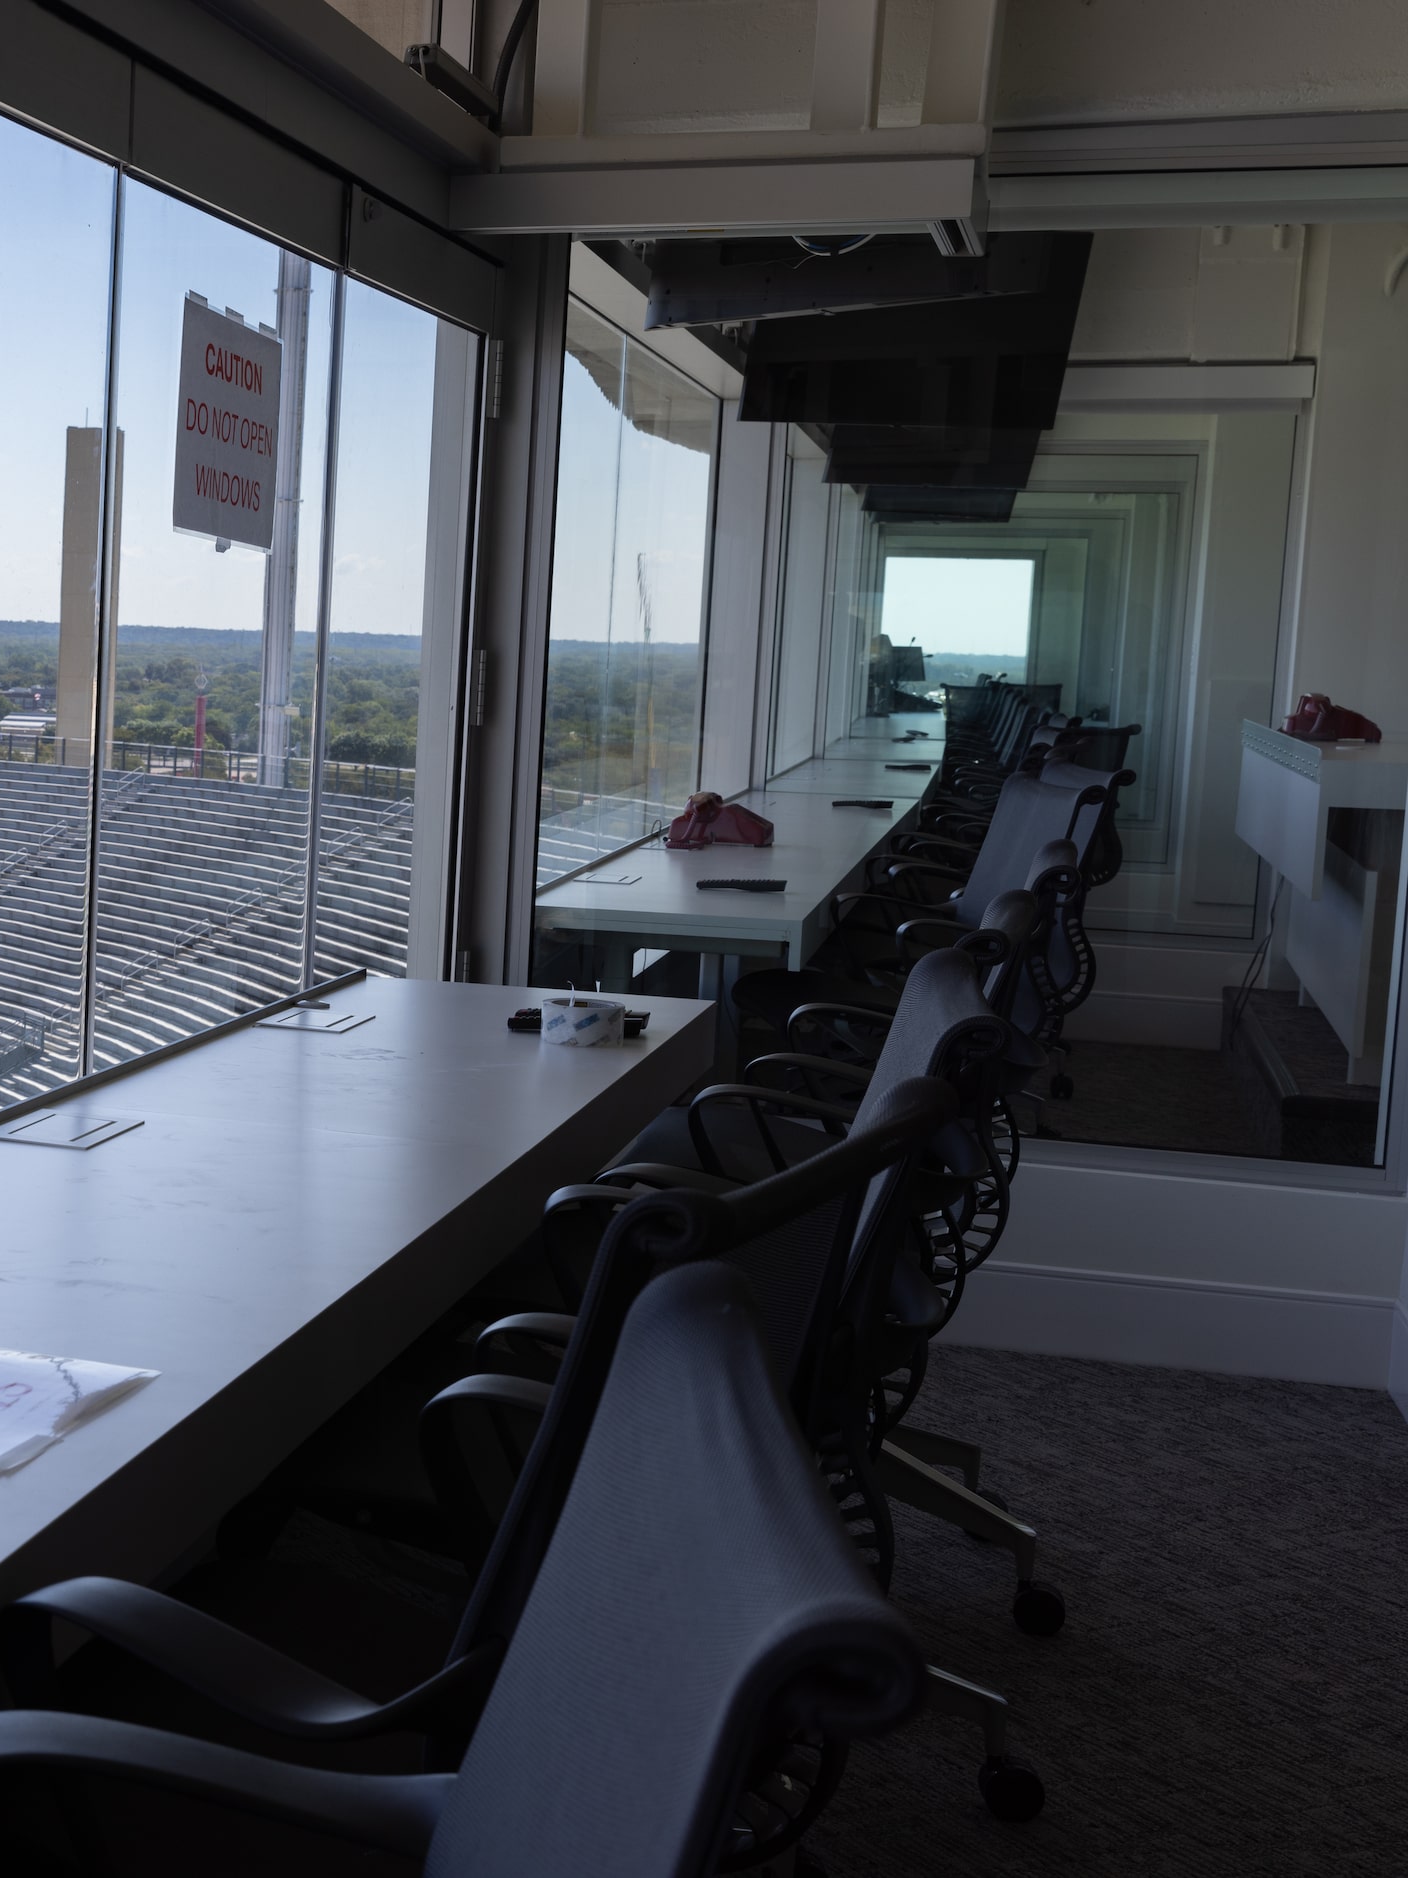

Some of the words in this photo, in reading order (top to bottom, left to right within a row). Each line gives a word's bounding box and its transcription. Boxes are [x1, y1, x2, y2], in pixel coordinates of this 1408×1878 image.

[205, 343, 262, 395] CAUTION
[186, 398, 209, 435] DO
[212, 407, 239, 445] NOT
[240, 418, 273, 457] OPEN
[196, 463, 260, 512] WINDOWS
